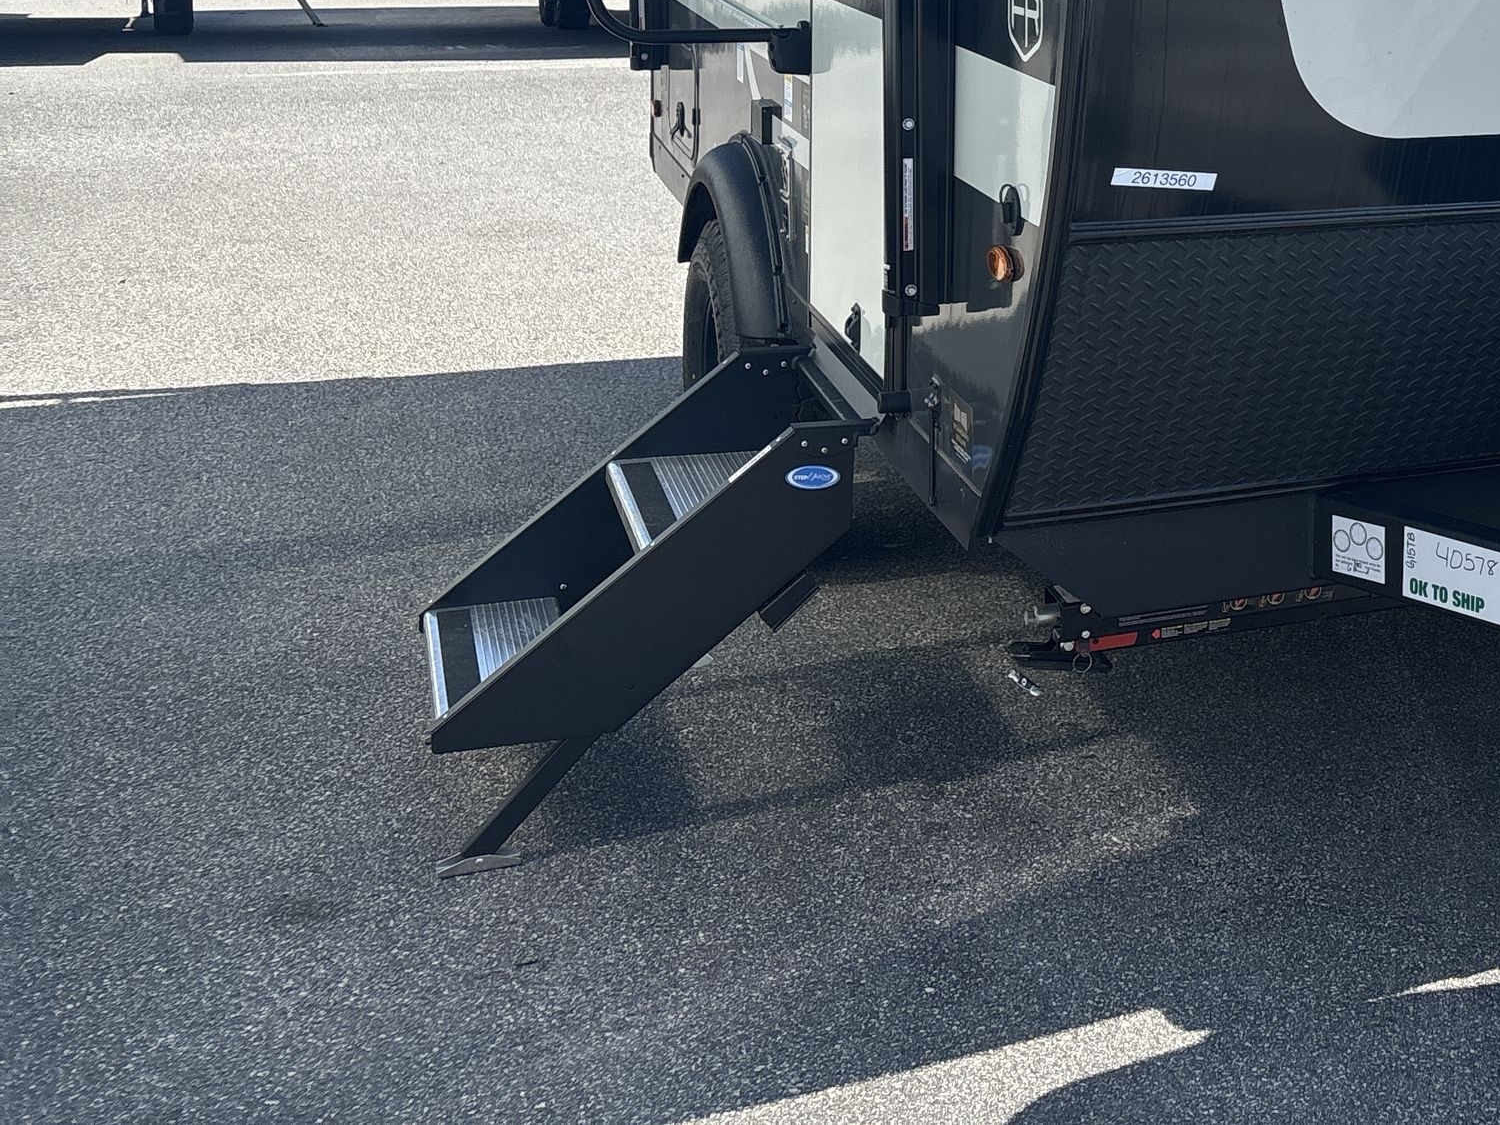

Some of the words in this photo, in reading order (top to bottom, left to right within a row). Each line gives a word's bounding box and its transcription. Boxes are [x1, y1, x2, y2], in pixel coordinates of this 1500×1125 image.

[1131, 170, 1197, 187] 2613560
[1435, 541, 1500, 576] 40578
[1409, 577, 1429, 598] OK
[1431, 583, 1448, 604] TO
[1452, 589, 1485, 614] SHIP
